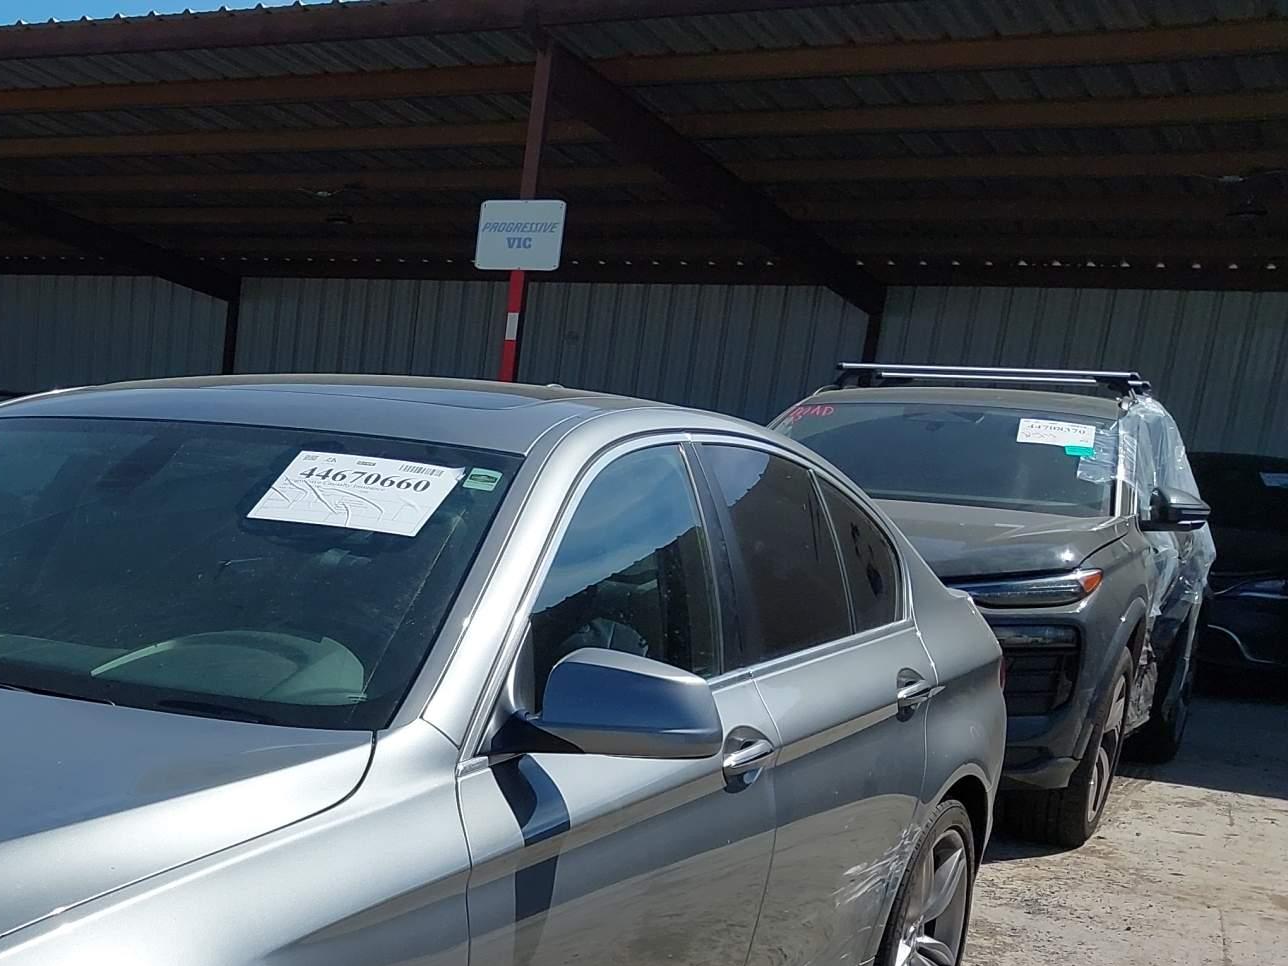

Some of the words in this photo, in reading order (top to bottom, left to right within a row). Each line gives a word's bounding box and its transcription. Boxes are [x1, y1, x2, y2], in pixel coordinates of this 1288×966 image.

[482, 222, 560, 233] PROGRESSIVE
[507, 237, 533, 249] VIC
[299, 466, 431, 492] 44670660
